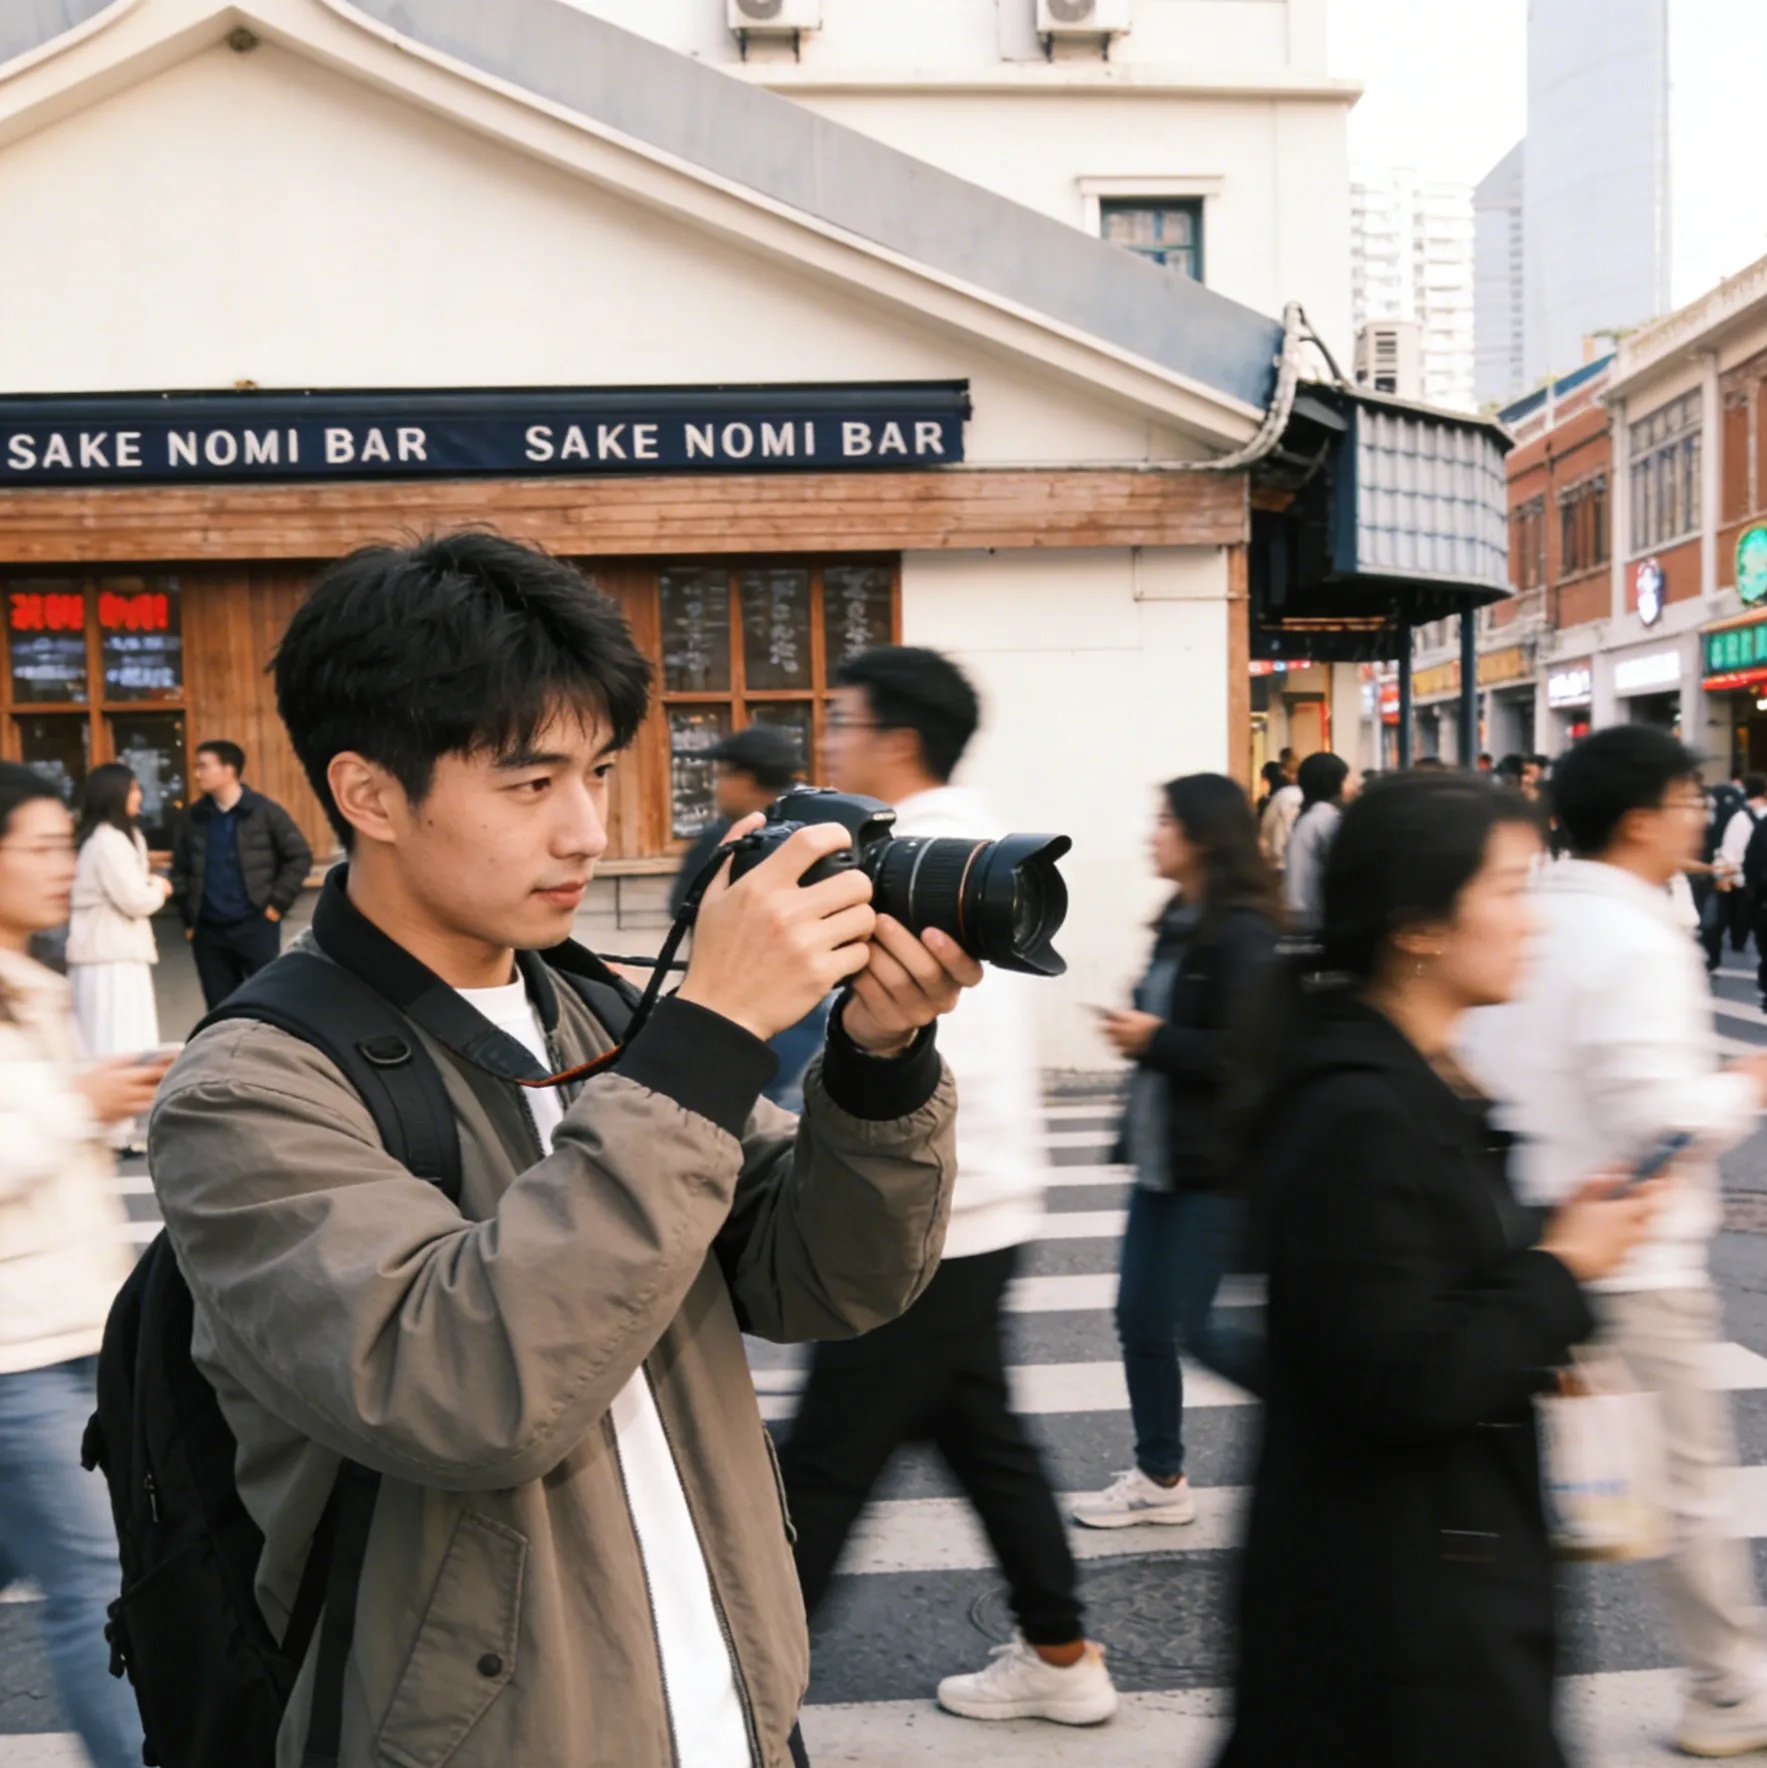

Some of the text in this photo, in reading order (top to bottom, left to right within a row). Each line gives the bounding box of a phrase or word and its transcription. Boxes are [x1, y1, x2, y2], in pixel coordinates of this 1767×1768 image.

[7, 426, 428, 470] SAKE NOMI BAR
[525, 420, 944, 462] SAKE NOMI BAR
